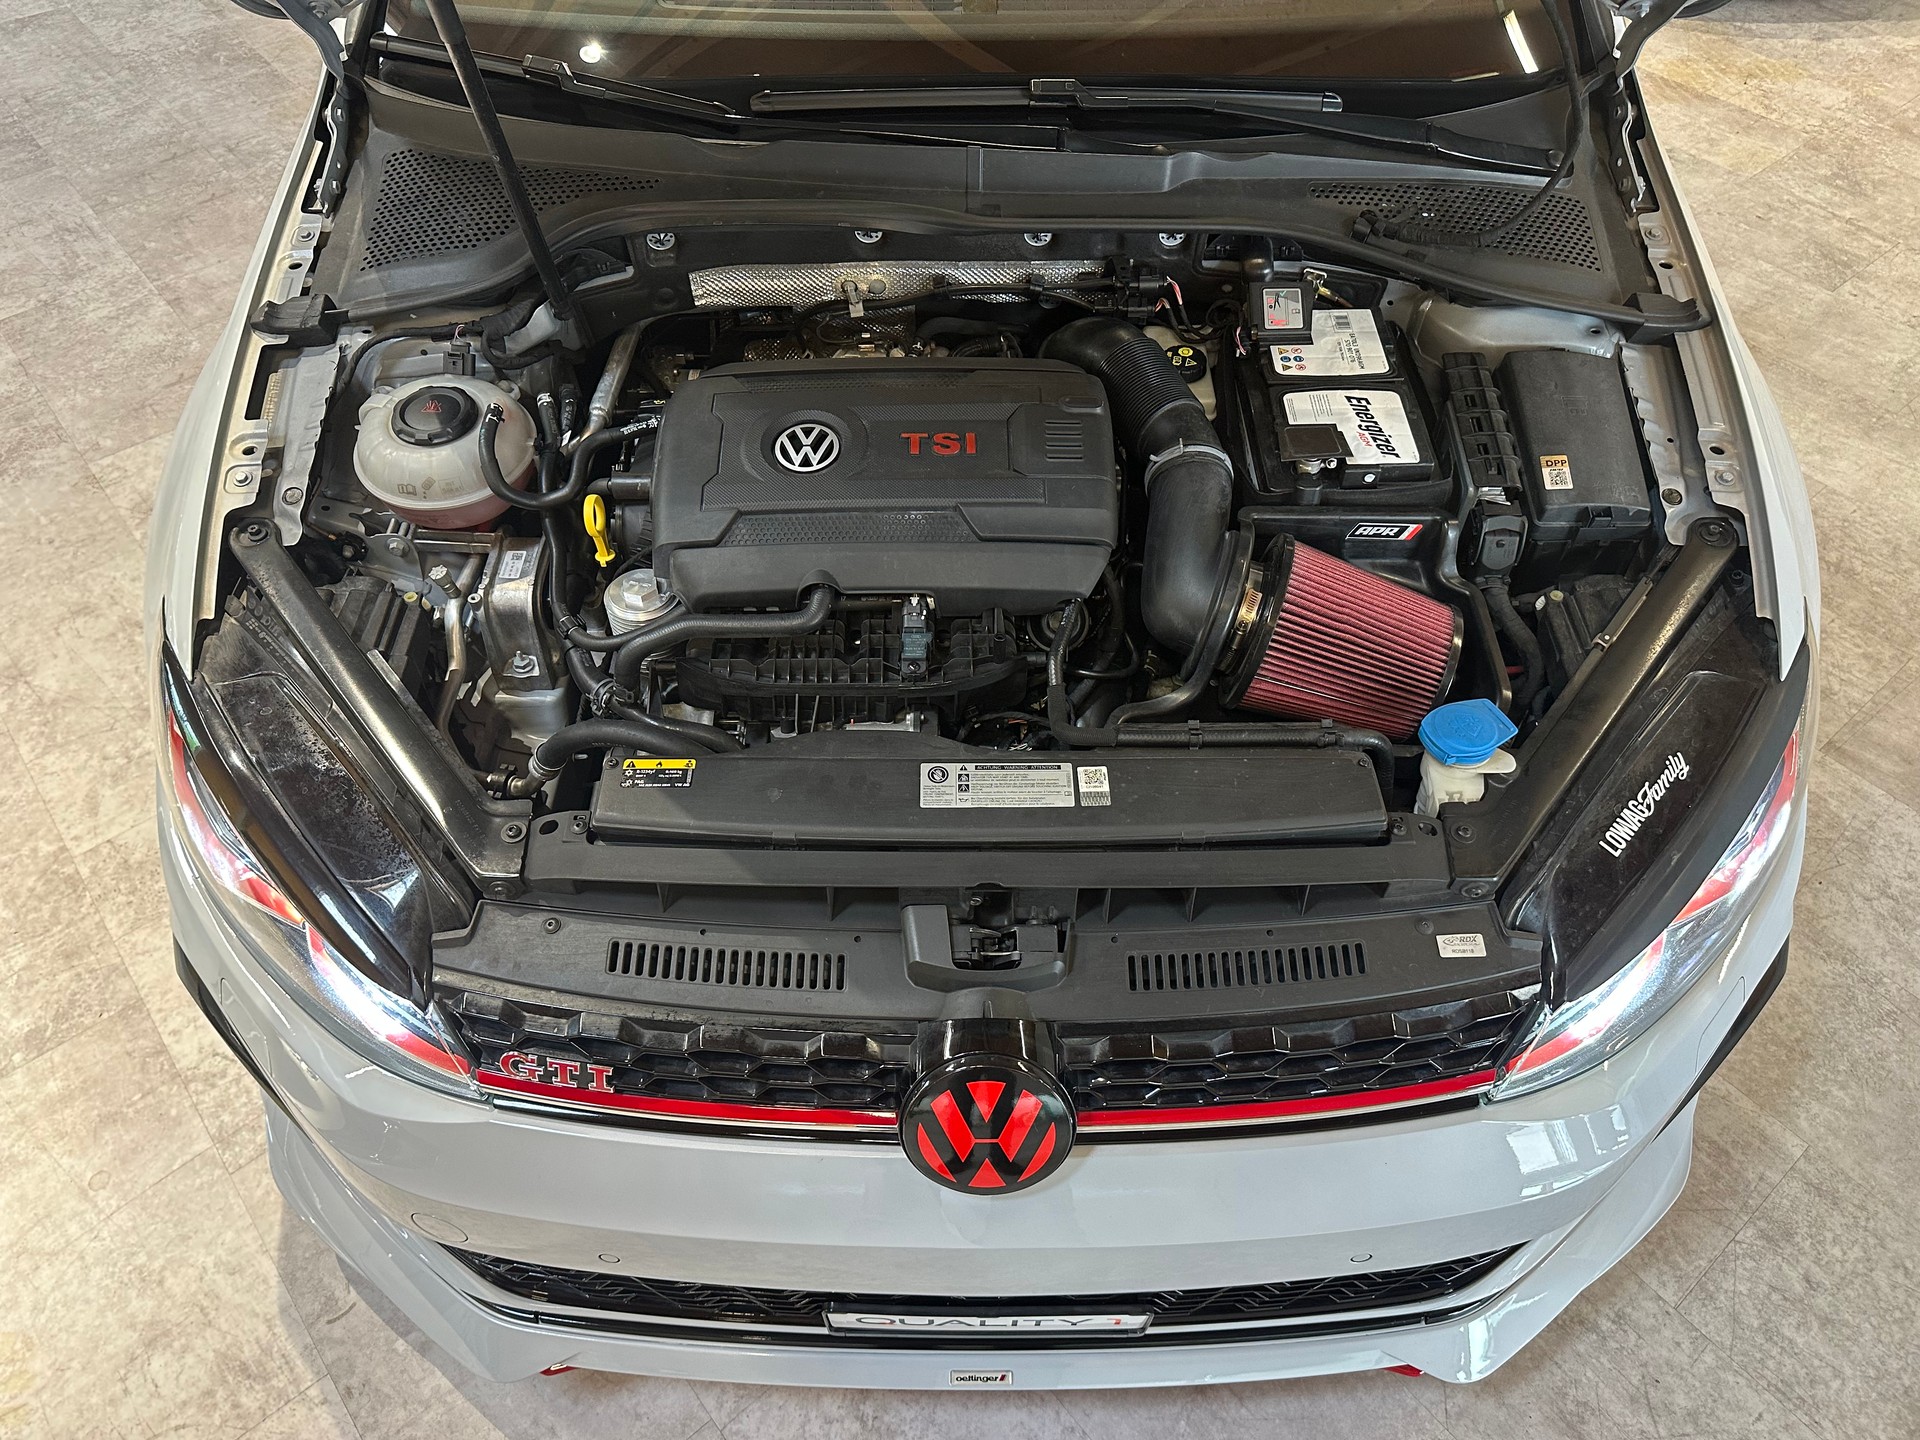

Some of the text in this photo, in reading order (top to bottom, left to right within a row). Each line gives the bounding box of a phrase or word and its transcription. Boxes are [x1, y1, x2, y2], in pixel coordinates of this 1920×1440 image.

[1344, 395, 1401, 458] Energizer
[901, 432, 977, 455] TSI
[1356, 431, 1372, 447] AGM
[1545, 459, 1567, 467] DPP
[1354, 526, 1400, 536] APR
[500, 1051, 615, 1093] GTI
[856, 1317, 1093, 1327] QUALITY
[955, 1374, 999, 1383] oettinger
